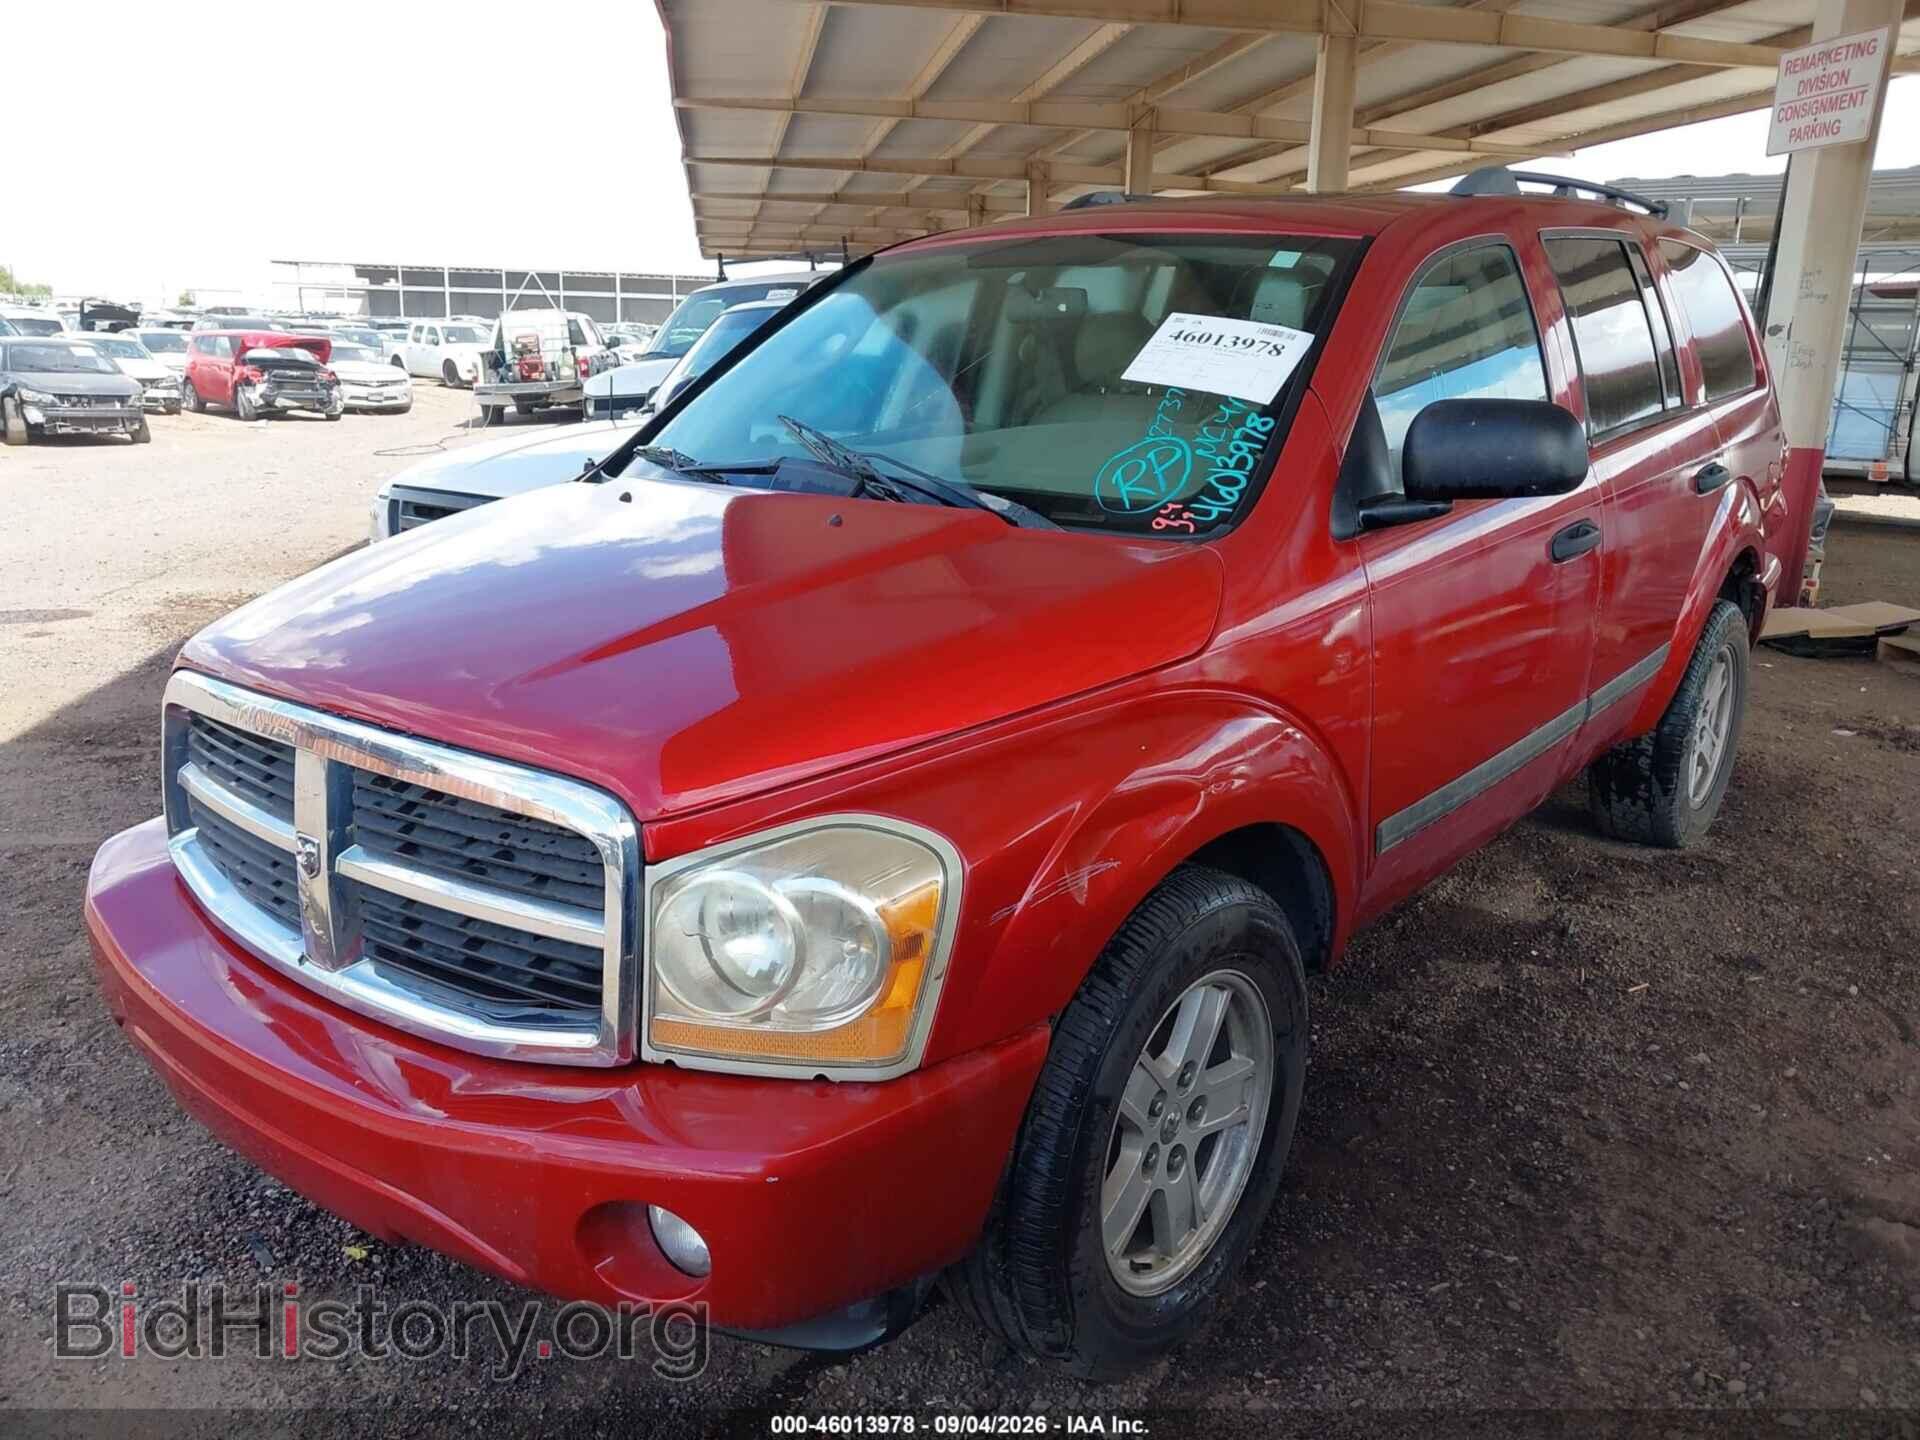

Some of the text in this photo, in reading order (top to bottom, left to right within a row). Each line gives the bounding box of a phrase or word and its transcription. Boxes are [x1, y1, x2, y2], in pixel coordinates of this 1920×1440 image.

[1785, 39, 1877, 76] REMARKETING
[1798, 70, 1851, 96] DIVISION
[1778, 91, 1867, 122] CONSIGNMENT
[1788, 119, 1841, 144] PARKING
[1168, 329, 1286, 357] 46013978
[1190, 412, 1275, 520] 46013978
